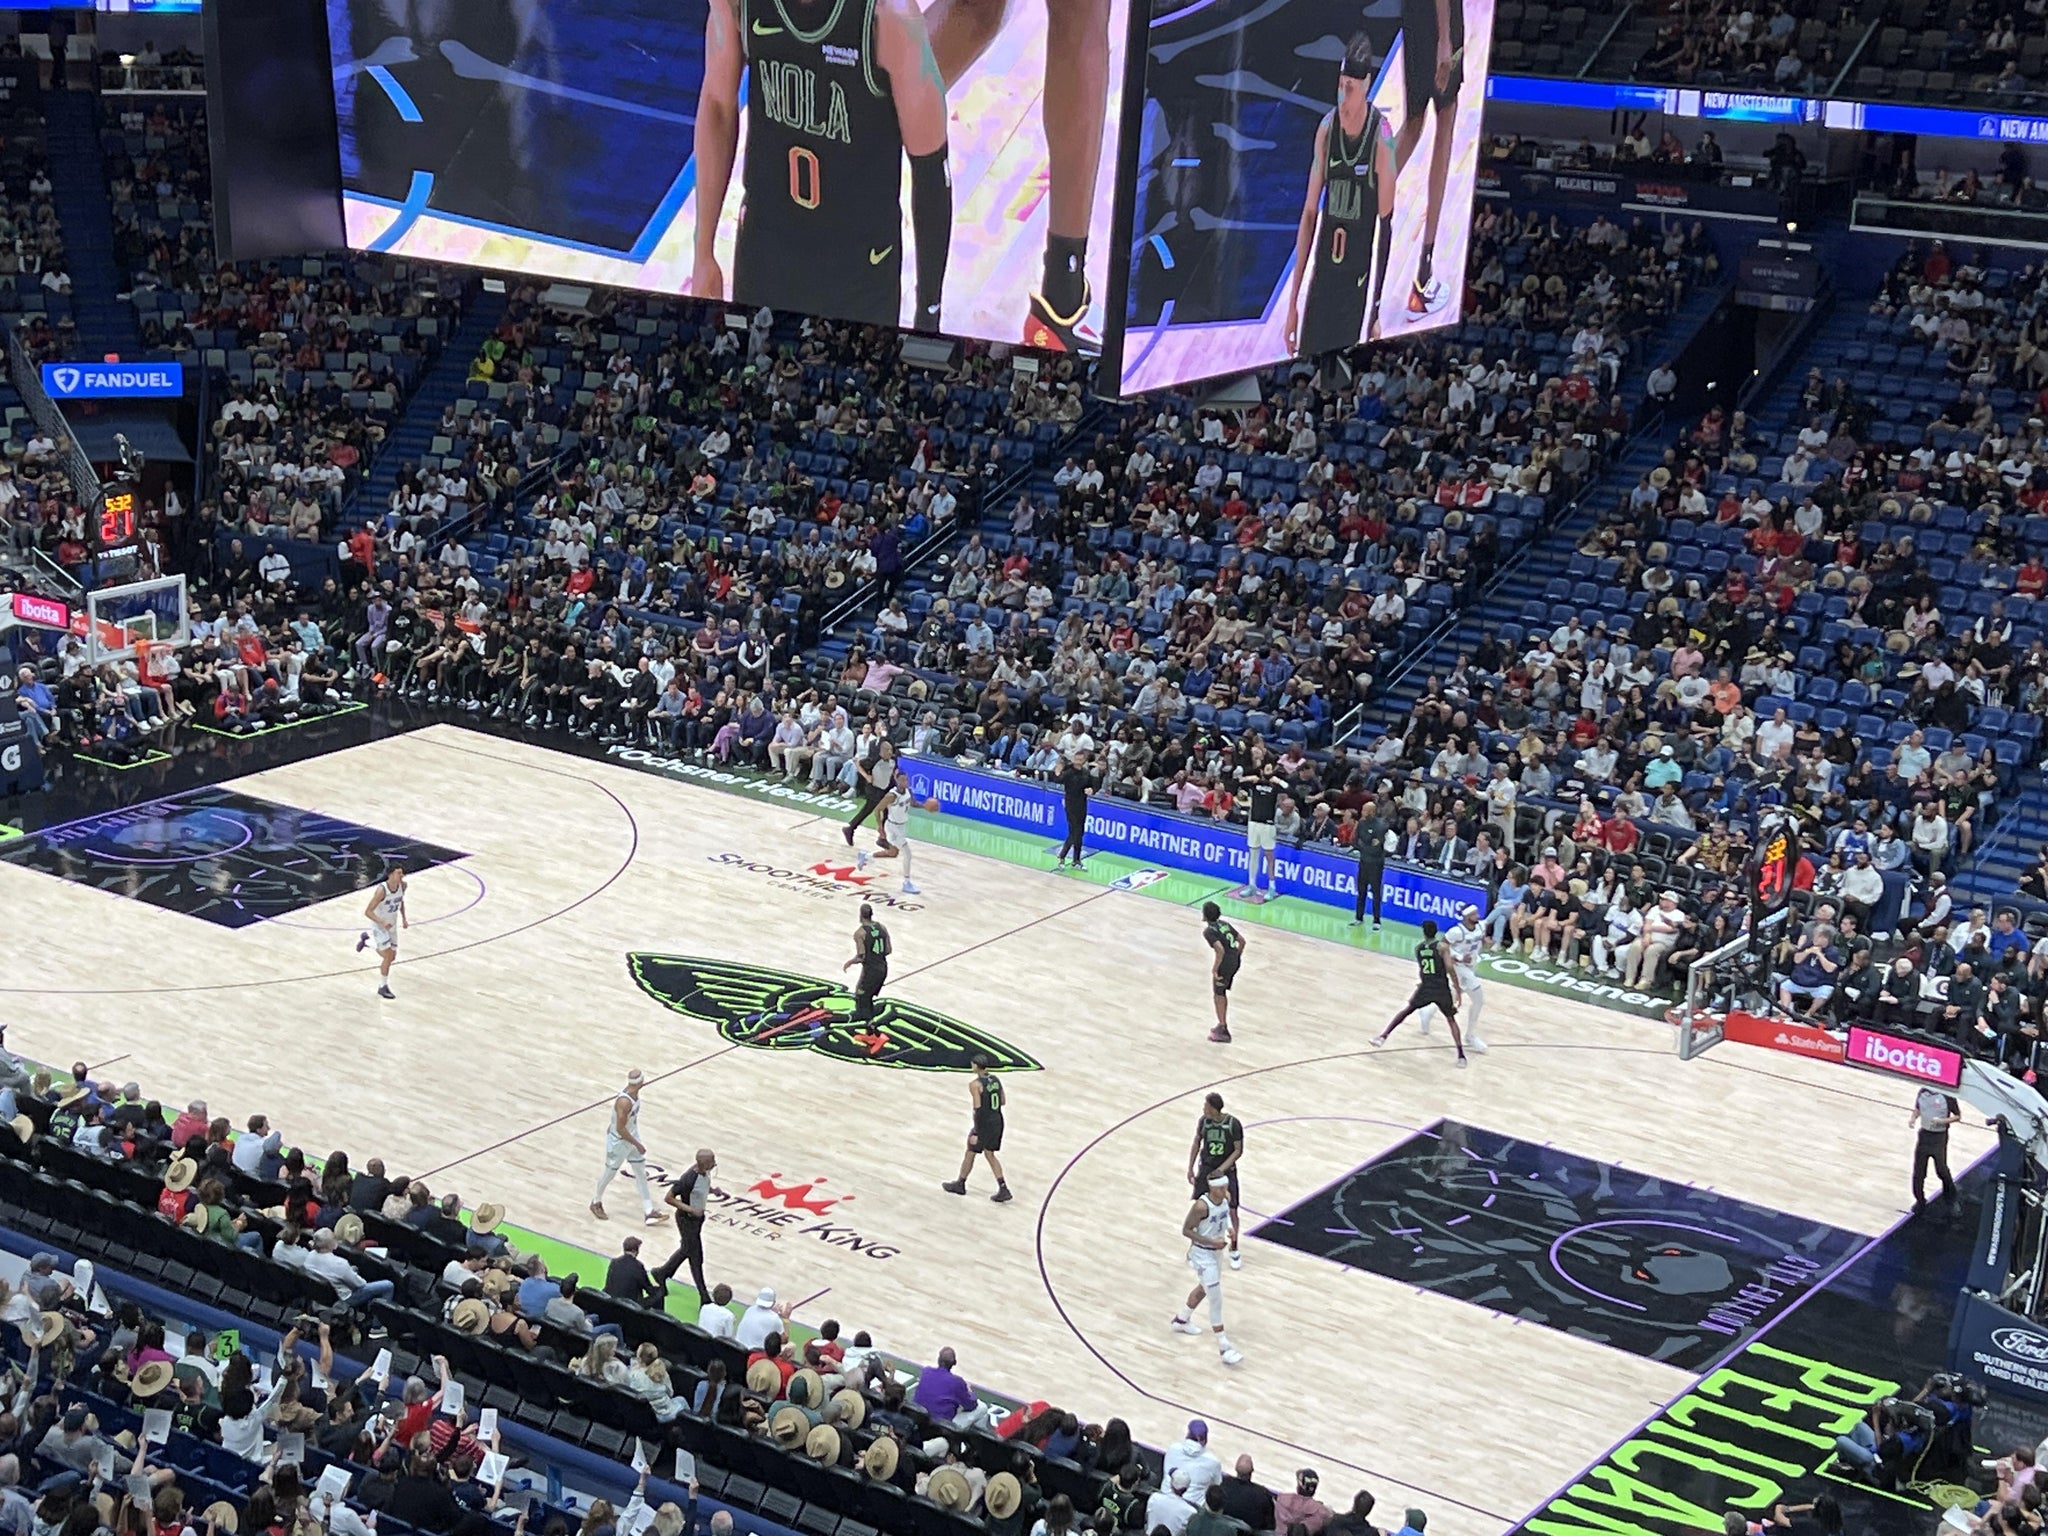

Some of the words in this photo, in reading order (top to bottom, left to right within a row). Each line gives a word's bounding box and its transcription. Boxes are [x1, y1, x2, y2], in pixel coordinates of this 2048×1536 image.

[759, 60, 851, 144] NOLA
[1704, 92, 1728, 108] NEW
[1728, 94, 1792, 114] AMSTERDAM
[2000, 119, 2030, 139] NEW
[789, 146, 820, 209] 0
[84, 372, 173, 388] FANDUEL
[21, 598, 60, 623] ibotta
[620, 750, 752, 785] Ochsner
[743, 779, 858, 813] Health
[932, 779, 961, 803] NEW
[962, 785, 1044, 823] AMSTERDAM
[707, 853, 851, 892] SMOOTHIE
[1129, 826, 1200, 858] PARTNER
[1204, 842, 1225, 864] OF
[1228, 847, 1249, 870] TH
[1303, 866, 1373, 899] ORLEA
[1382, 884, 1466, 921] PELICANS
[766, 880, 836, 901] CENTER
[1421, 958, 1436, 975] 21
[1491, 960, 1673, 1009] Ochsner
[1865, 1036, 1942, 1077] ibotta
[991, 1093, 1000, 1110] 0
[1208, 1142, 1225, 1155] 22
[620, 1164, 804, 1227] SMOTHIE
[221, 1335, 233, 1358] 3
[2002, 1331, 2048, 1360] Ford
[1973, 1351, 2028, 1375] SOUTHERN
[1984, 1364, 2012, 1380] FORD
